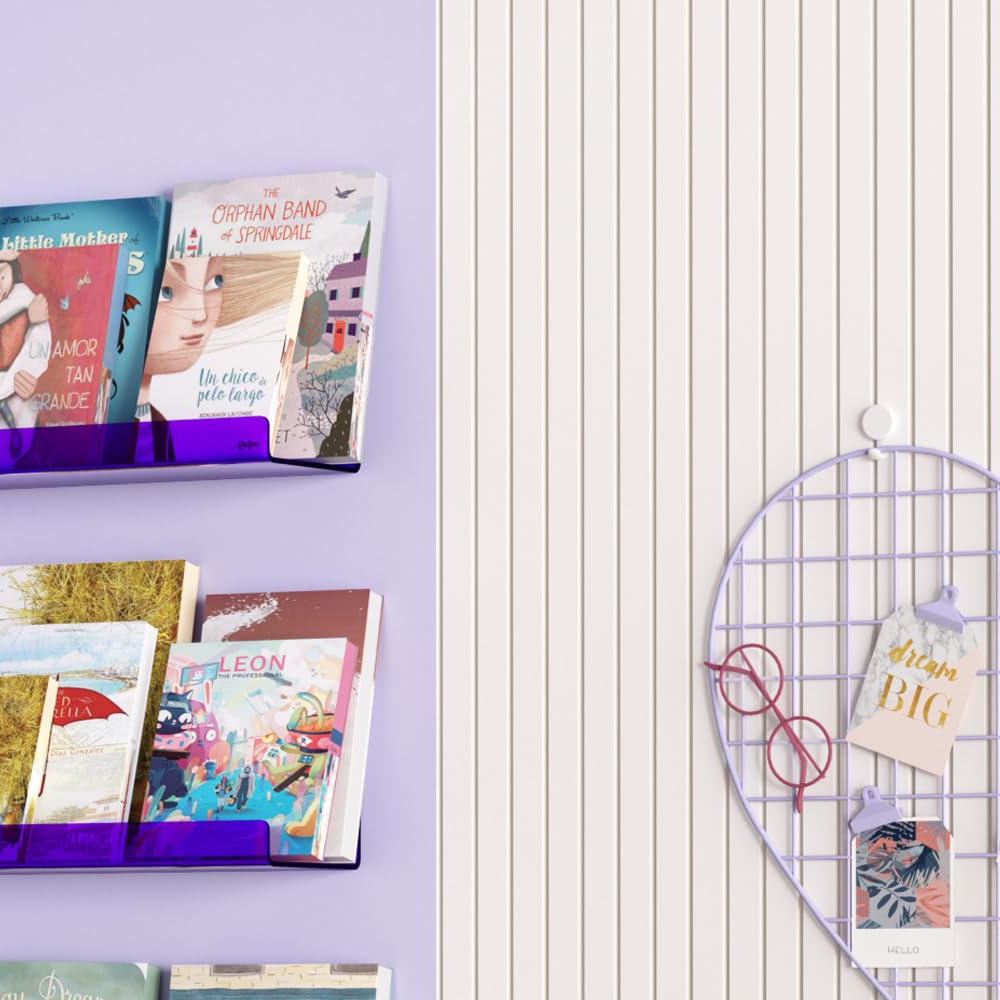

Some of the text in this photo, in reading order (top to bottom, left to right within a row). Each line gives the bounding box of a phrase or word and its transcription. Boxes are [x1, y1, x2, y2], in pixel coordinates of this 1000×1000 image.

[263, 188, 280, 198] THE
[212, 199, 327, 225] ORPHAN BAND
[1, 234, 54, 251] Little
[58, 231, 128, 248] Mother
[221, 223, 313, 243] of SPRINGDALE
[29, 338, 98, 359] UN AMOR
[65, 365, 94, 385] TAN
[199, 367, 217, 387] Un
[222, 367, 257, 385] chico
[28, 392, 91, 411] GRANDE
[196, 386, 265, 409] pelo largo
[219, 654, 287, 673] LEON
[888, 638, 959, 682] dream
[876, 671, 953, 729] BIG
[887, 945, 919, 955] HELLO
